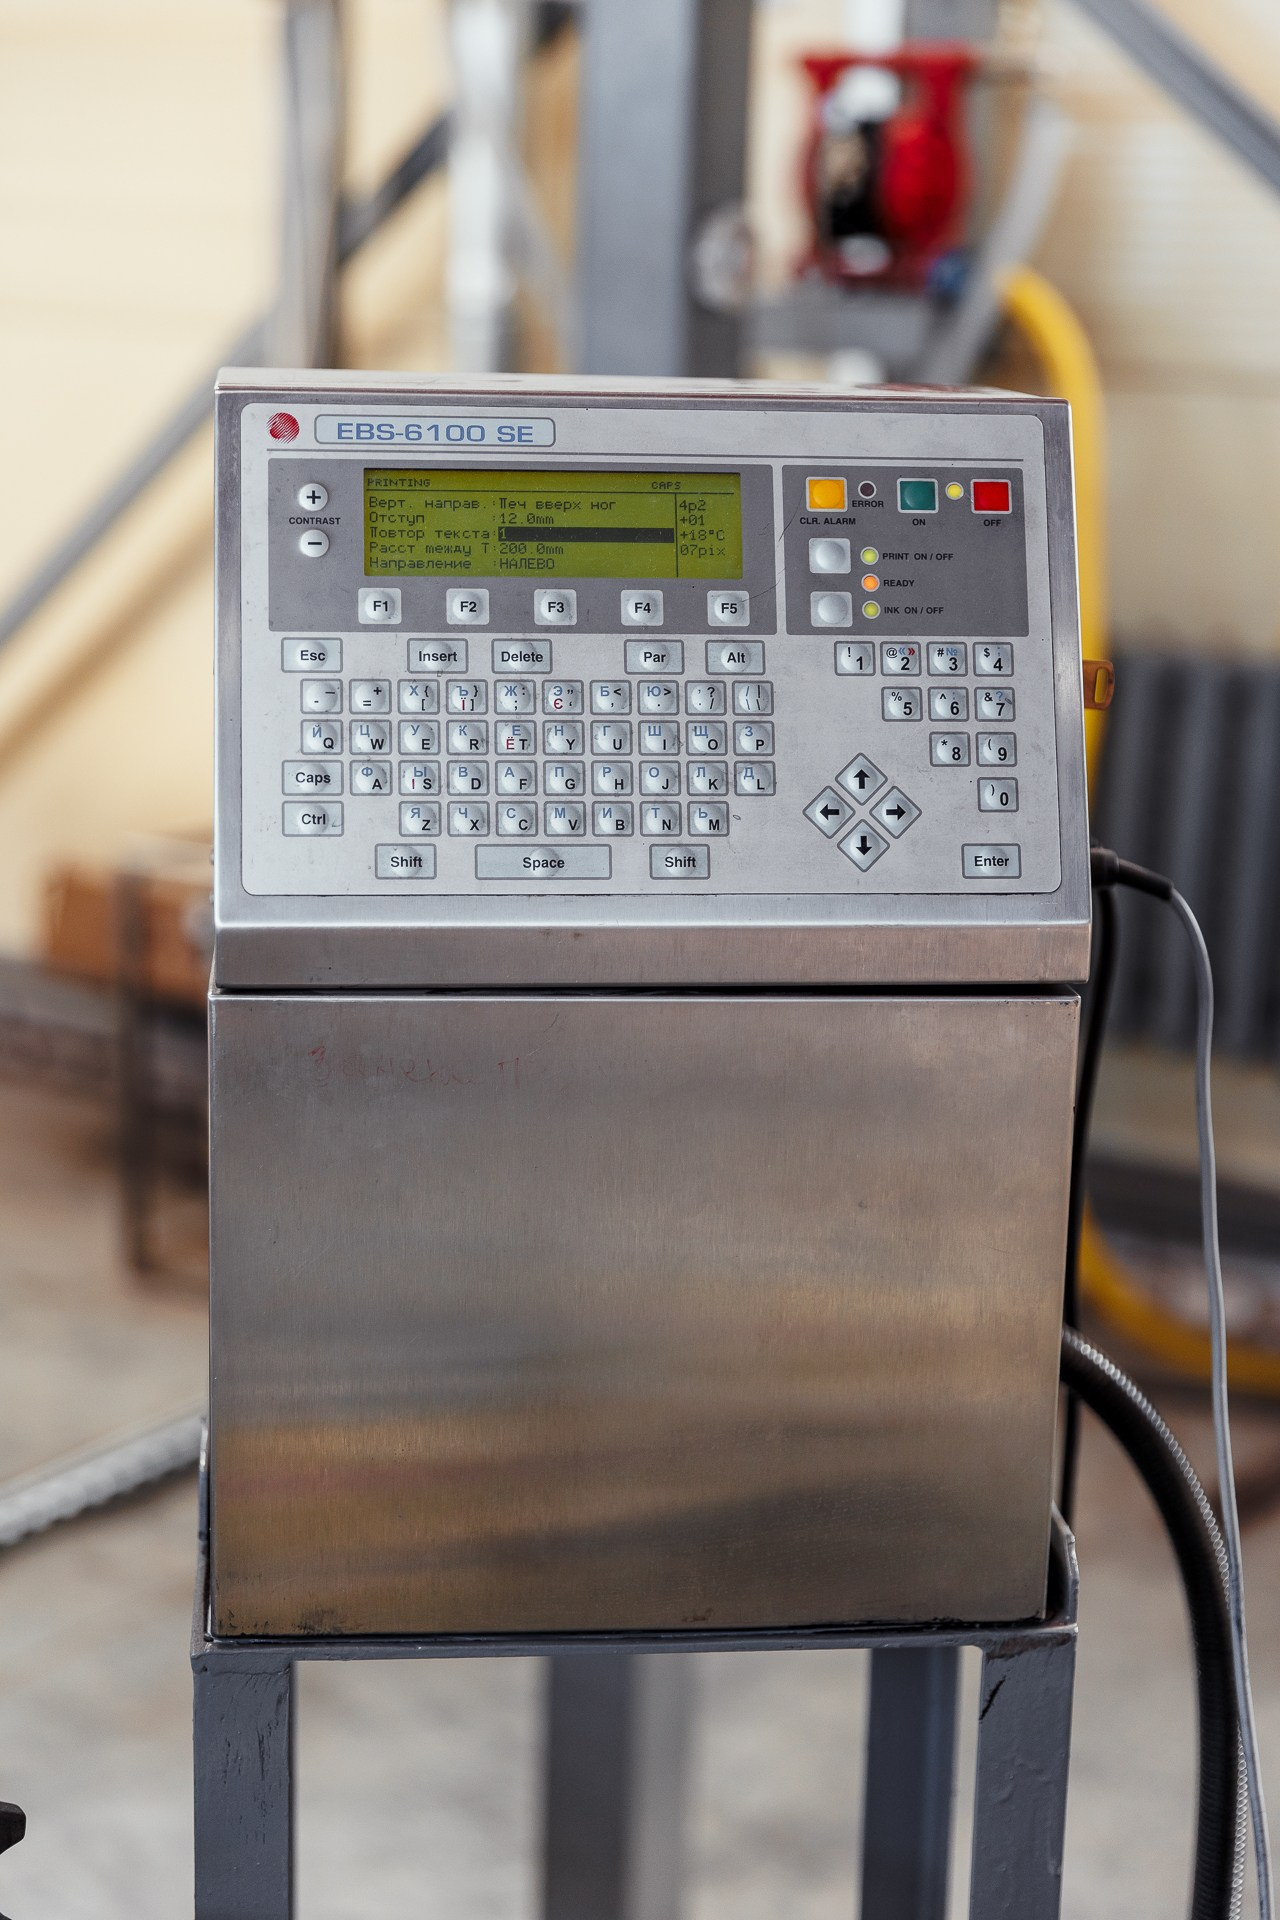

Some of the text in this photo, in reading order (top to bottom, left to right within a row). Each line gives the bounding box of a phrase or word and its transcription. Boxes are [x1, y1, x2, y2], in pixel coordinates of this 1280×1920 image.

[337, 422, 534, 443] EBS-6100 SE
[368, 478, 431, 487] PRINTING
[369, 496, 413, 508] Верт.
[536, 501, 581, 512] вверх
[591, 502, 616, 510] ног
[289, 517, 340, 525] CONTRAST
[369, 512, 424, 526] Отступ
[680, 515, 705, 525] +01
[370, 527, 424, 540] Повтор
[370, 542, 415, 553] Расст
[426, 544, 471, 556] между
[680, 545, 725, 558] 07pix
[370, 558, 471, 570] Направление
[373, 601, 389, 611] F1
[460, 602, 477, 612] F2
[548, 602, 564, 612] F3
[634, 603, 651, 613] F4
[721, 604, 737, 614] F5
[301, 650, 325, 661] Esc
[419, 651, 457, 662] Insert
[501, 651, 543, 662] Delete
[644, 652, 666, 662] Par
[727, 653, 745, 663] Alt
[856, 657, 863, 670] 1
[901, 657, 910, 670] 2
[949, 658, 958, 671] 3
[993, 658, 1003, 671] 4
[903, 703, 912, 715] 5
[950, 702, 959, 715] 6
[996, 703, 1005, 716] 7
[323, 738, 334, 749] Q
[371, 739, 384, 749] W
[422, 739, 430, 749] E
[470, 739, 479, 750] R
[519, 739, 527, 750] T
[566, 739, 575, 750] Y
[613, 739, 622, 750] U
[663, 739, 666, 750] I
[708, 739, 718, 750] O
[756, 740, 764, 750] P
[952, 747, 961, 760] 8
[998, 748, 1007, 761] 9
[296, 772, 331, 785] Caps
[372, 779, 382, 789] A
[423, 779, 432, 789] S
[472, 778, 481, 789] D
[520, 779, 527, 789] F
[565, 779, 575, 789] G
[615, 779, 624, 789] H
[662, 779, 669, 790] J
[709, 779, 718, 790] K
[757, 779, 765, 790] L
[302, 814, 326, 824] Ctrl
[422, 820, 430, 830] Z
[470, 820, 479, 830] X
[519, 820, 528, 830] C
[569, 820, 578, 830] V
[616, 820, 624, 830] B
[662, 820, 671, 830] N
[709, 820, 720, 830] M
[391, 856, 422, 867] Shift
[523, 857, 565, 870] Space
[665, 857, 696, 867] Shift
[975, 856, 1009, 867] Enter
